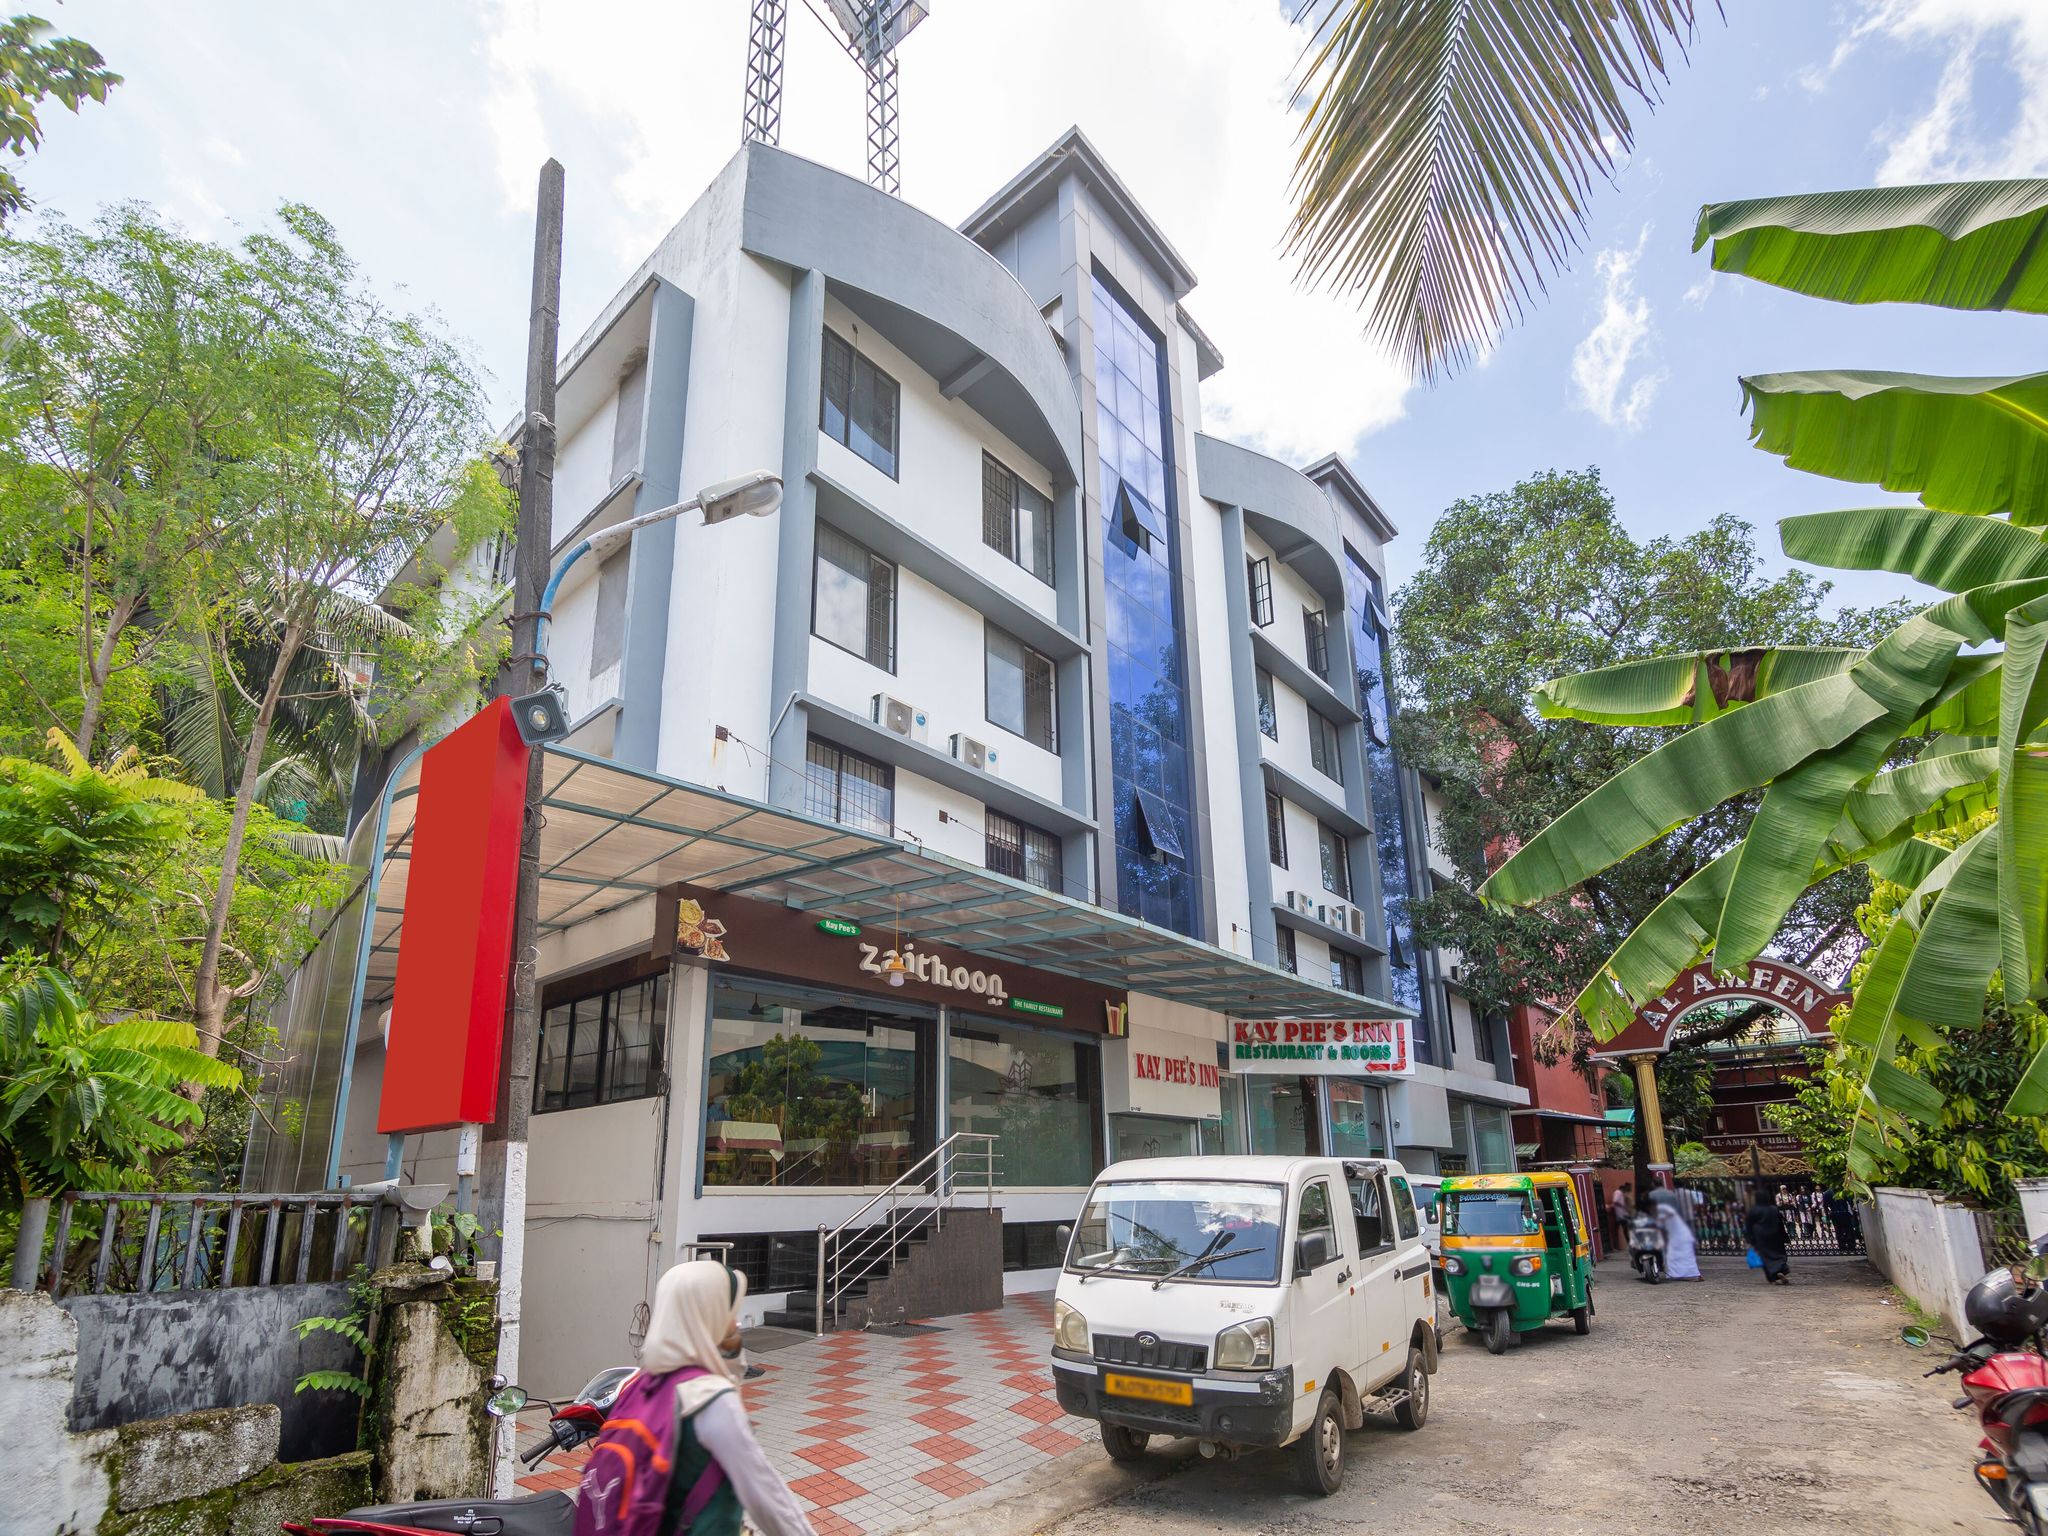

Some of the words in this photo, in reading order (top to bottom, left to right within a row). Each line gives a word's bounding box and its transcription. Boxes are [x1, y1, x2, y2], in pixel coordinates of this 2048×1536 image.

[825, 921, 838, 930] Kay
[1014, 1000, 1023, 1008] THE
[1023, 1001, 1038, 1011] FAMILY
[1038, 1004, 1064, 1016] RESTAURANT
[1235, 1022, 1278, 1042] KAY
[1284, 1022, 1348, 1043] PEE'S
[1353, 1022, 1393, 1043] INN
[1235, 1044, 1325, 1060] RESTAURANT
[1328, 1045, 1338, 1060] &
[1341, 1044, 1392, 1060] ROOMS
[1136, 1053, 1161, 1080] KAY
[1164, 1055, 1196, 1086] PEE'S
[1198, 1063, 1220, 1089] INN
[1762, 1136, 1799, 1144] PUBLIC
